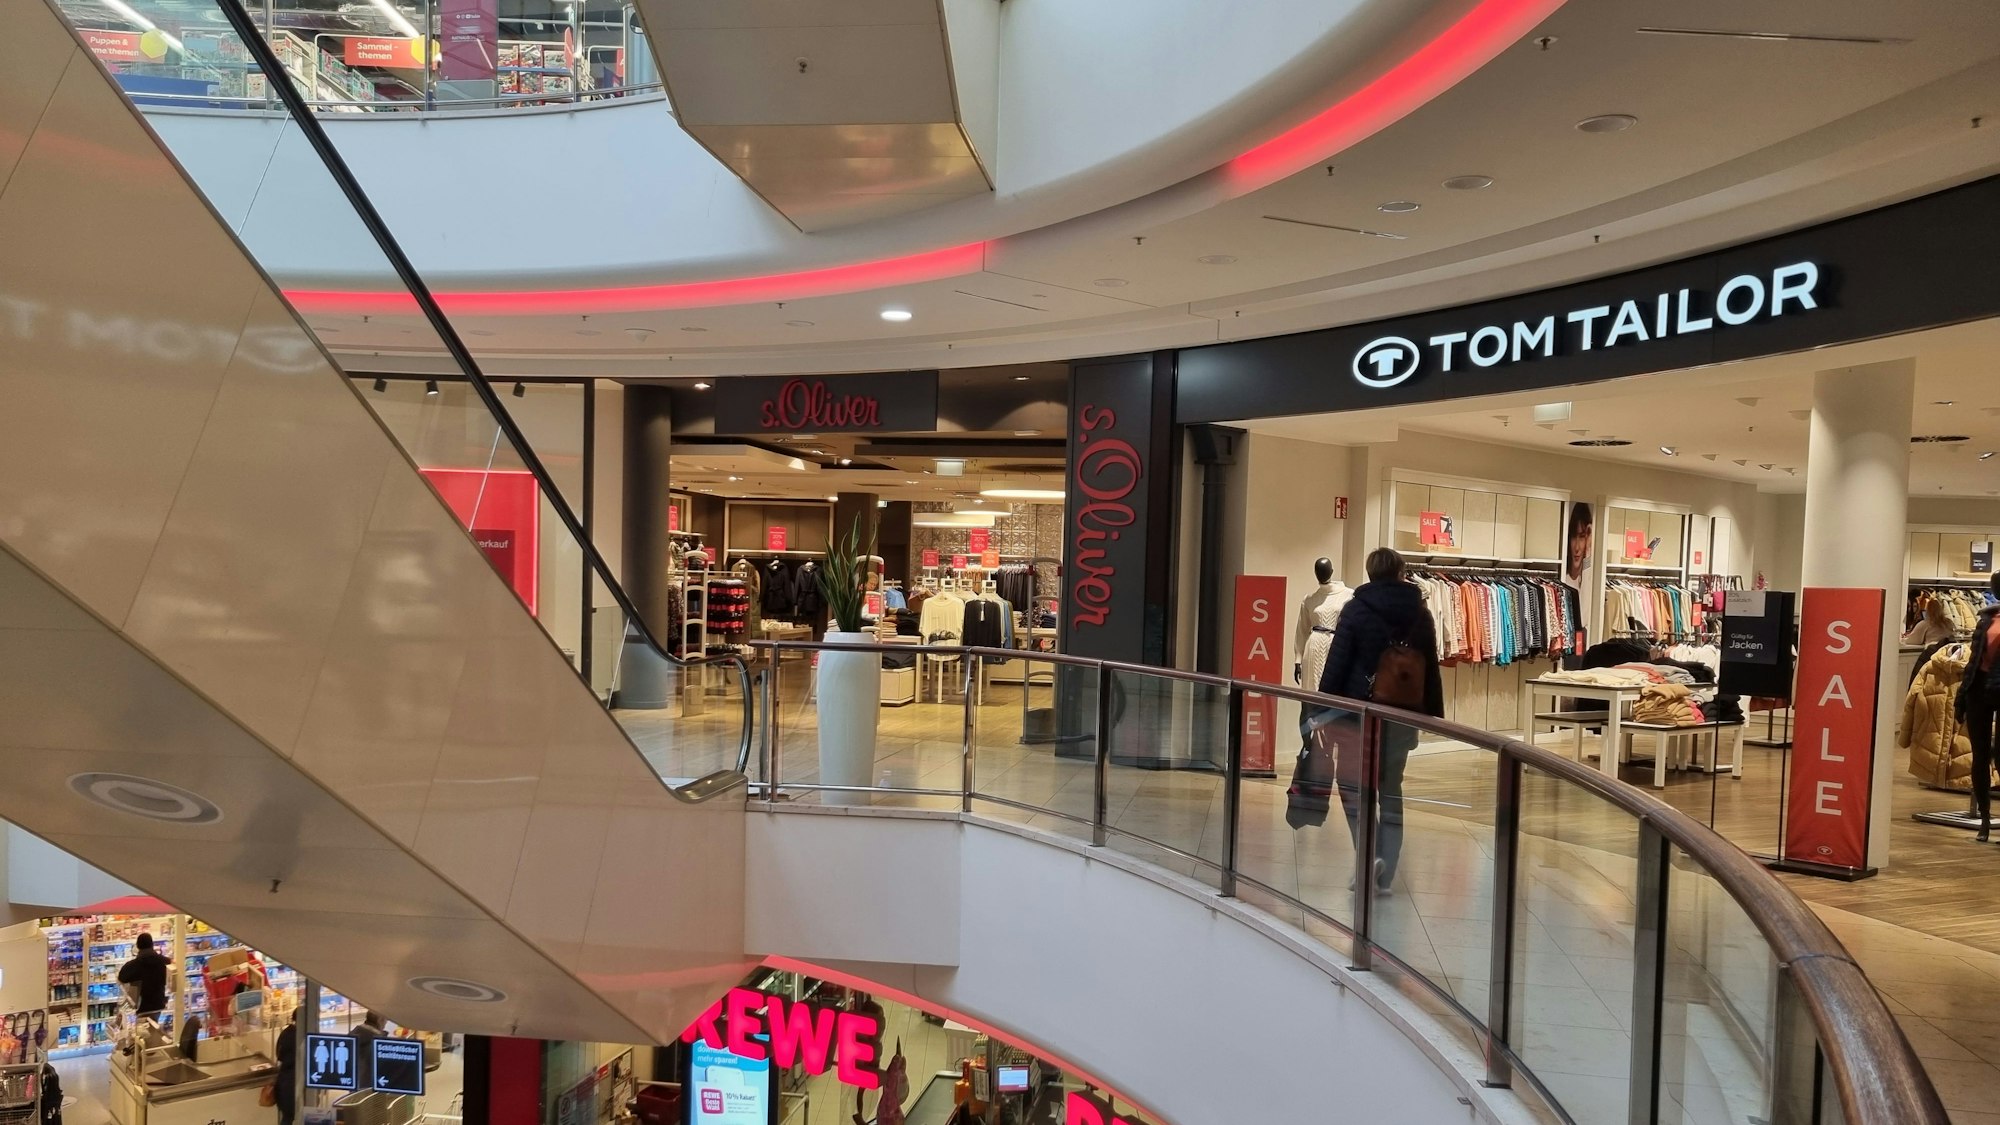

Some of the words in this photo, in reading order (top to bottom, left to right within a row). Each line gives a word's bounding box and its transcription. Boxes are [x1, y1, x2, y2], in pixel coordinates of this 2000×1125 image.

[90, 36, 121, 45] Puppen
[122, 38, 129, 46] &
[357, 42, 392, 51] Sammel
[108, 48, 139, 56] themen
[358, 51, 392, 59] themen
[1429, 316, 1554, 372] TOM
[1567, 261, 1819, 351] TAILOR
[760, 378, 880, 429] s.Oliver
[1074, 404, 1143, 632] s.Oliver
[1422, 518, 1437, 526] SALE
[478, 540, 508, 548] erkauf
[1729, 640, 1763, 650] Jacken
[1246, 599, 1270, 735] SALE
[1815, 620, 1853, 816] SALE
[714, 1056, 738, 1064] sparen!
[340, 1077, 352, 1085] WC
